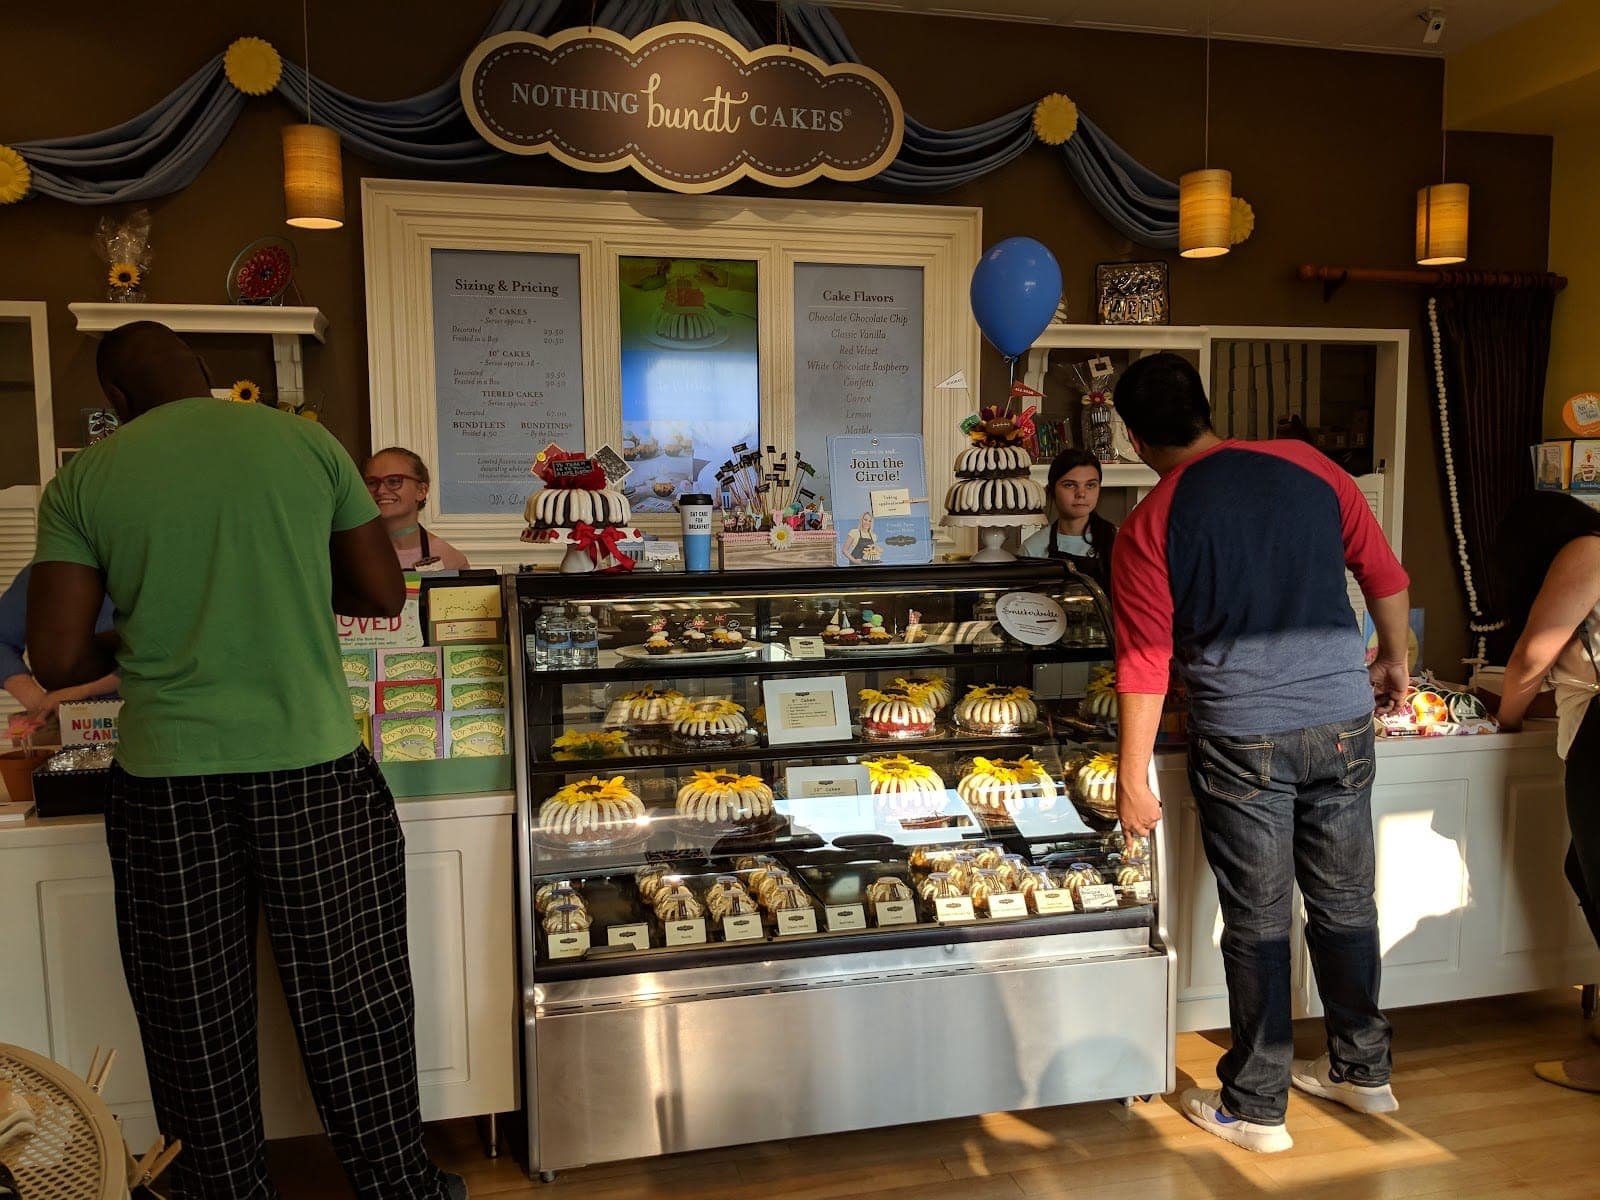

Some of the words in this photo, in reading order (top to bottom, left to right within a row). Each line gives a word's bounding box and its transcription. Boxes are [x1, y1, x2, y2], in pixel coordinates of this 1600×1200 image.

[511, 82, 640, 115] NOTHING
[640, 73, 749, 133] bundt
[455, 278, 495, 295] Sizing
[498, 280, 508, 291] &
[511, 280, 560, 297] Pricing
[822, 290, 850, 302] Cake
[854, 291, 894, 303] Flavors
[808, 312, 847, 322] Chocolate
[849, 313, 888, 323] Chocolate
[889, 314, 909, 326] Chip
[831, 329, 857, 339] Classic
[860, 329, 886, 339] Vanilla
[502, 350, 531, 358] CAKES
[839, 345, 854, 355] Red
[856, 345, 879, 355] Velvet
[807, 361, 830, 370] White
[833, 361, 870, 371] Chocolate
[872, 362, 909, 375] Raspberry
[843, 378, 874, 390] Confetti
[482, 390, 514, 398] TIERED
[846, 393, 871, 403] Carrot
[846, 409, 872, 418] Lemon
[844, 425, 873, 434] Marble
[849, 459, 879, 469] Join
[883, 458, 904, 469] the
[855, 471, 901, 482] Circle!
[83, 729, 119, 740] CAND
